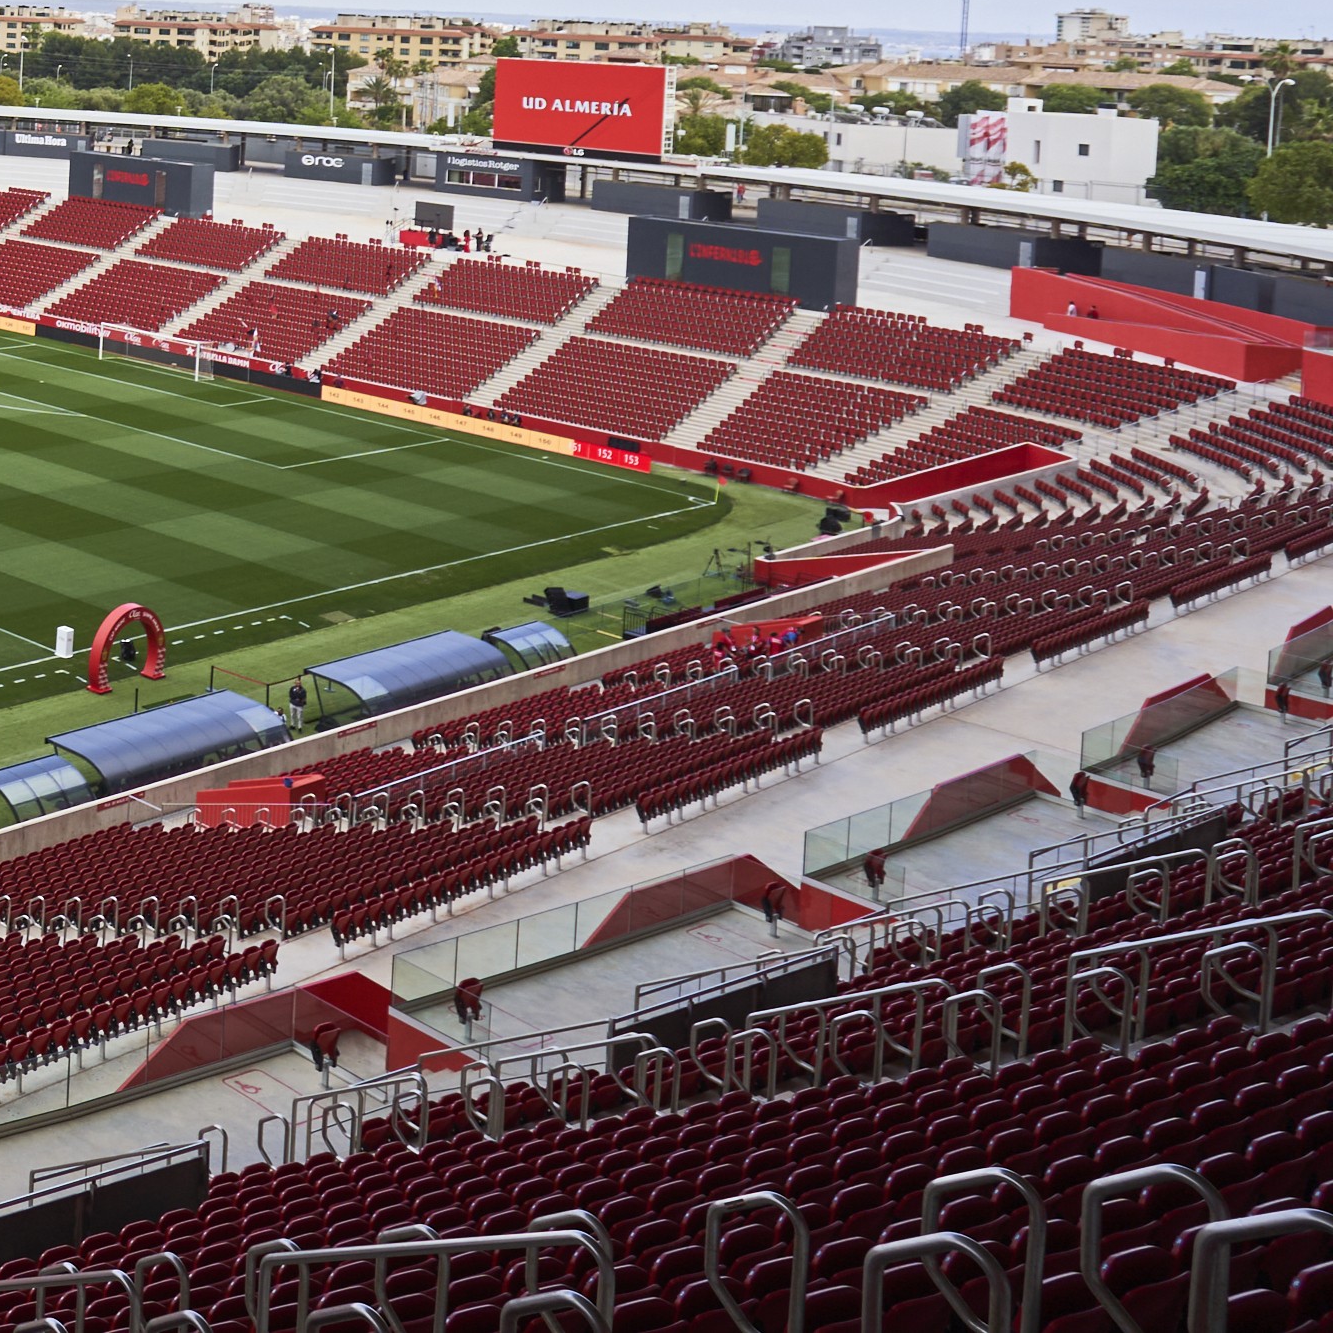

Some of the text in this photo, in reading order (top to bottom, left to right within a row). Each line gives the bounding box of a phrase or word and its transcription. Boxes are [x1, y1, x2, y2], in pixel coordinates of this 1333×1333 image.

[522, 96, 632, 117] UD ALMERÍA
[45, 135, 67, 146] Hora
[488, 160, 519, 172] Rotger
[228, 354, 249, 368] DAMM
[598, 448, 612, 459] 152
[624, 454, 639, 465] 153
